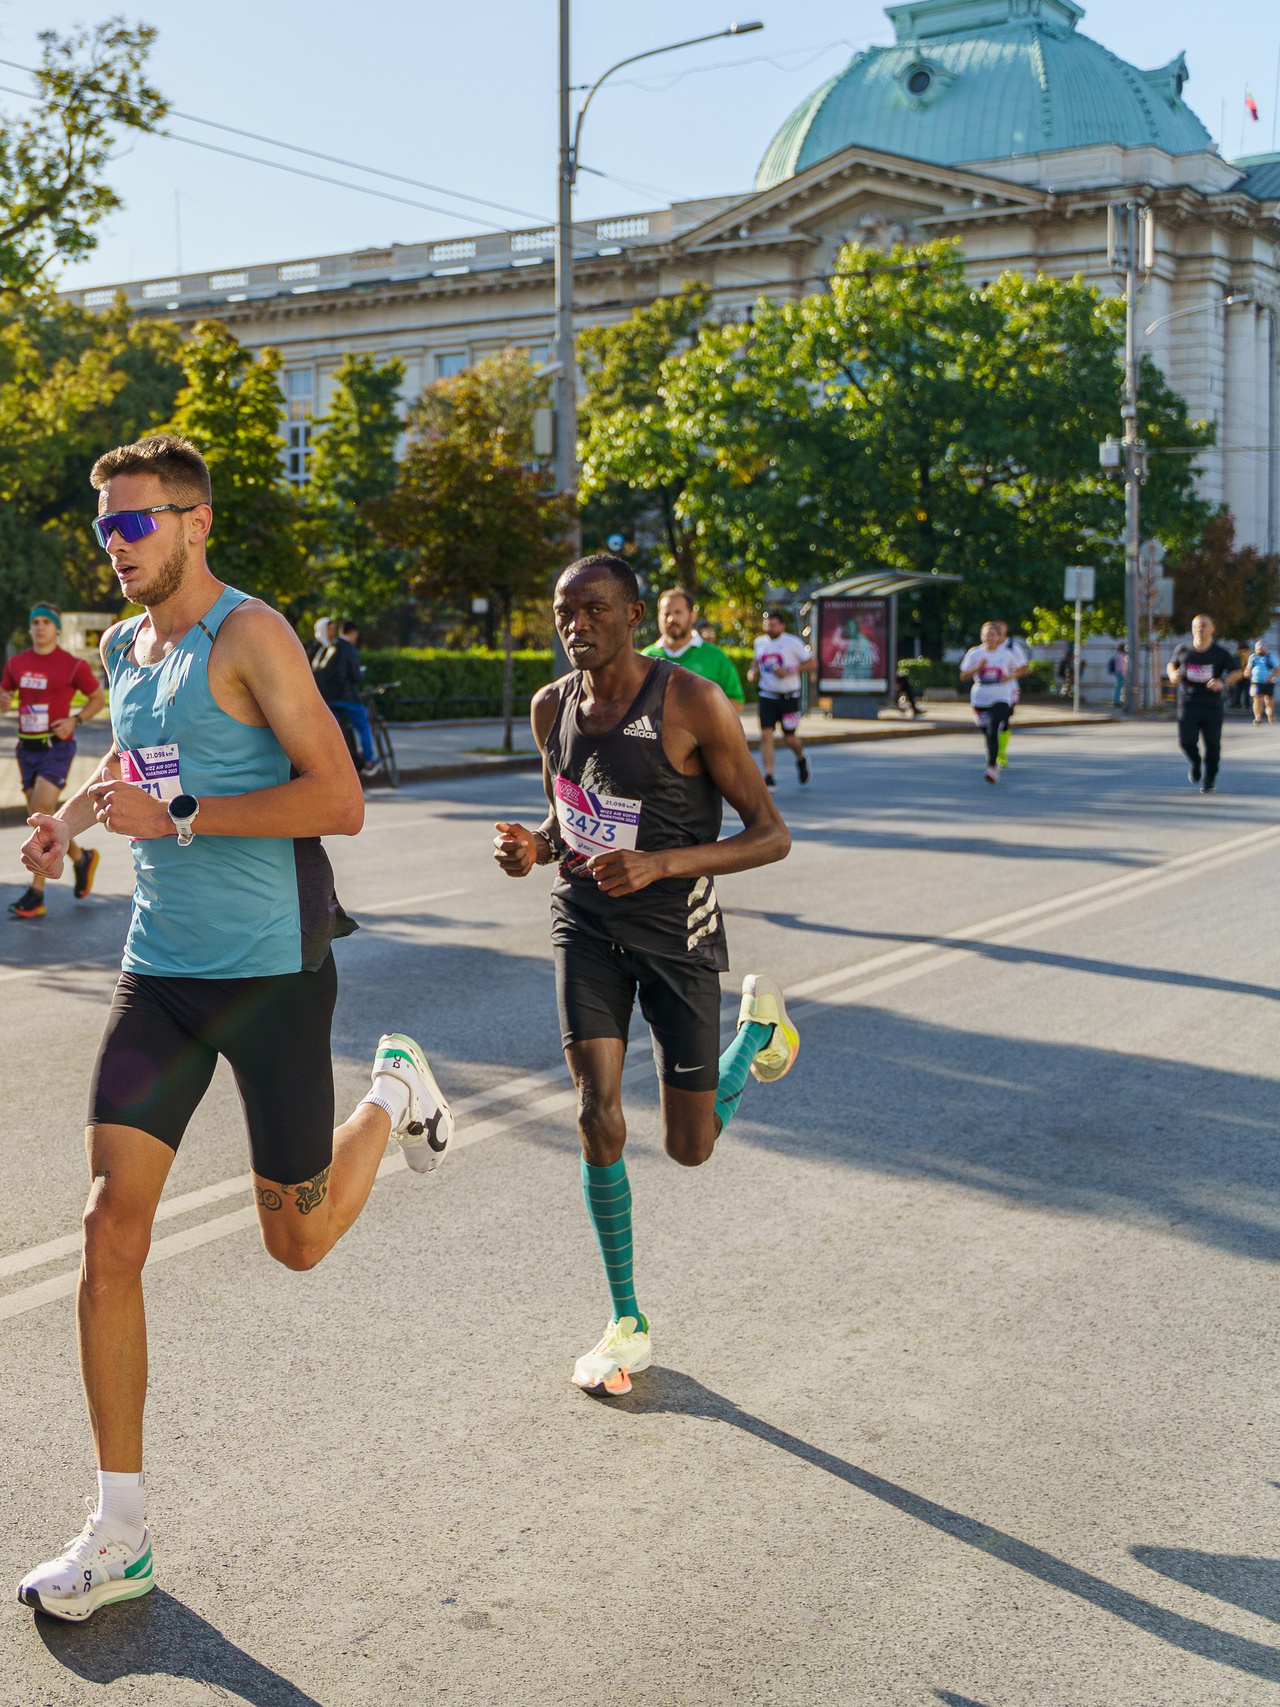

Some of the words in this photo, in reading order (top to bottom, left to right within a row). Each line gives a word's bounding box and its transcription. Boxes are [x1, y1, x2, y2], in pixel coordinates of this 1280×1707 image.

[623, 727, 657, 739] adidas
[146, 751, 165, 759] 21.098
[605, 800, 626, 808] 21.098
[600, 813, 625, 822] MARATHON
[566, 807, 617, 842] 2473
